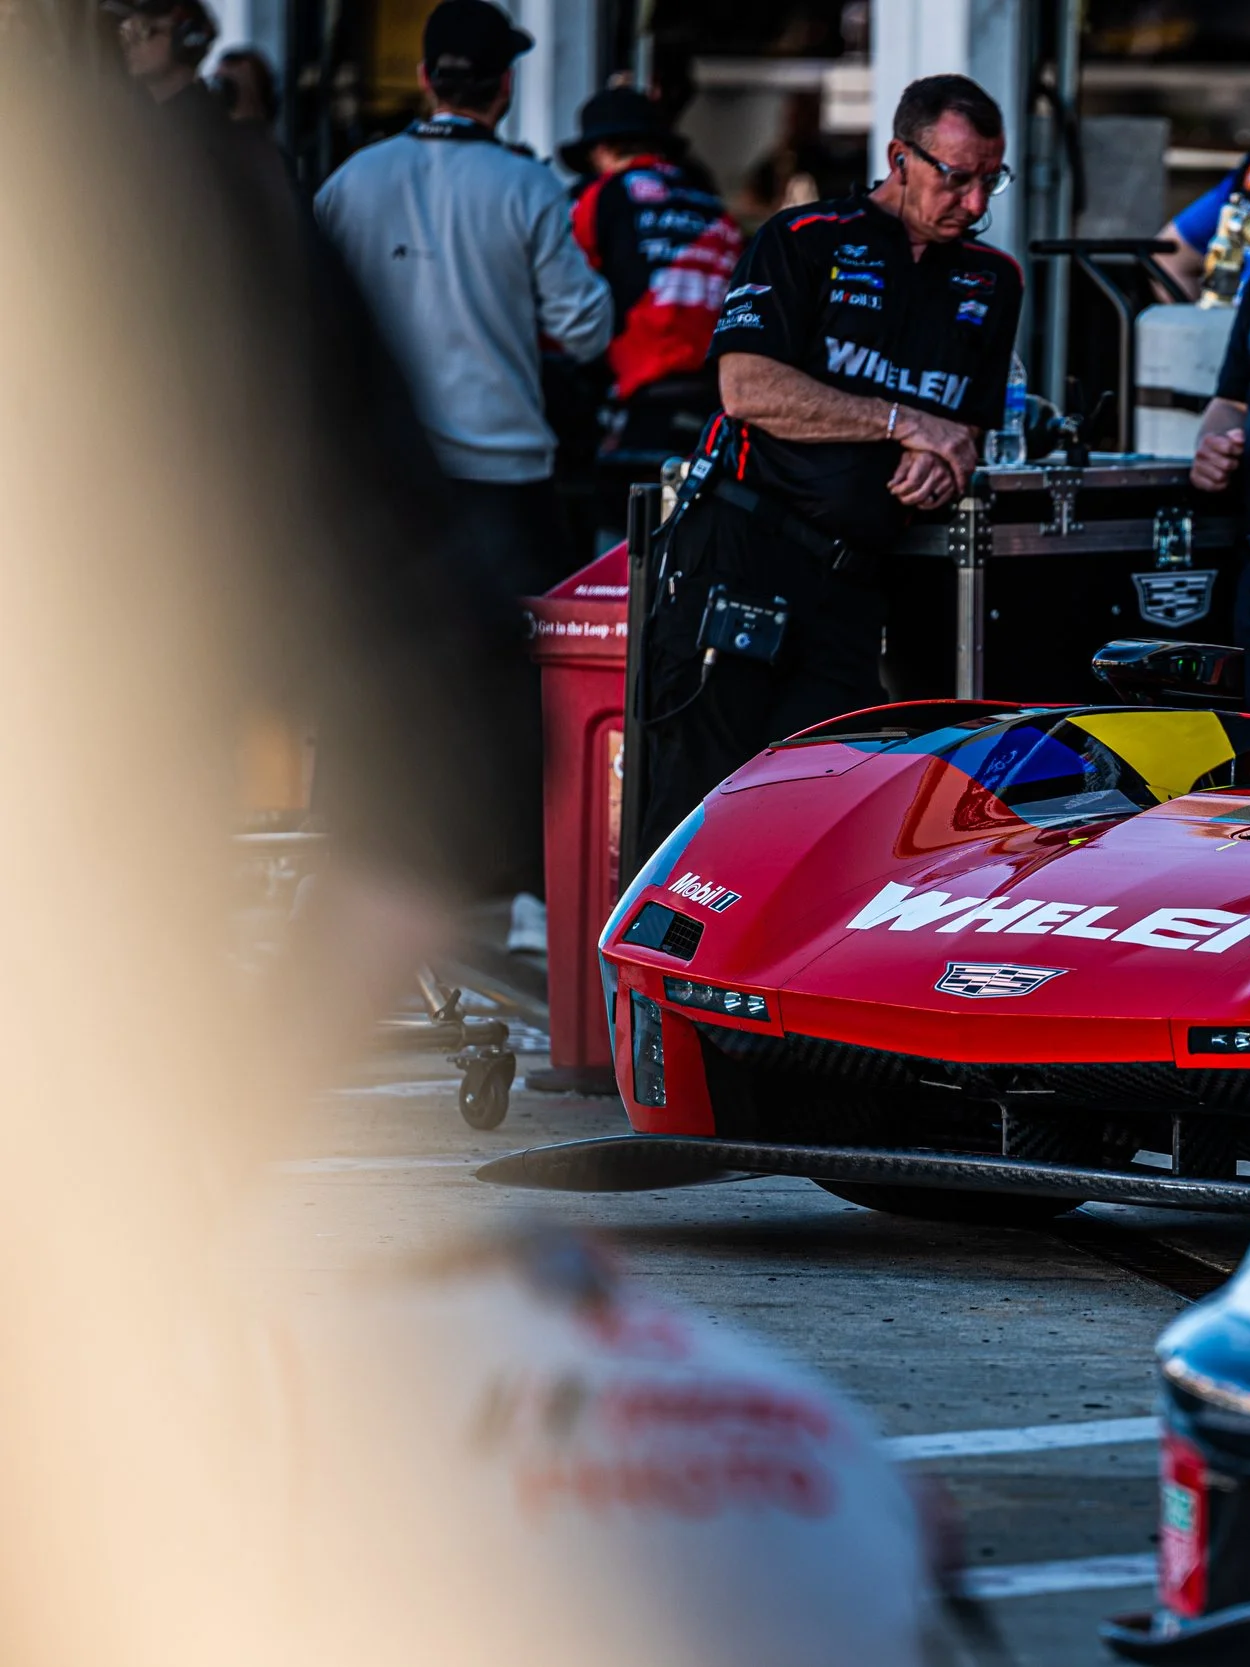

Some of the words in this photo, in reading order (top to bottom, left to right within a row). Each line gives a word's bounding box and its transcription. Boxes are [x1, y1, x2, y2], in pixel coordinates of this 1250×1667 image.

[825, 336, 971, 410] WHELEN
[538, 621, 554, 635] Get
[567, 621, 583, 635] the
[584, 622, 609, 639] Loop
[668, 872, 726, 906] Mobil
